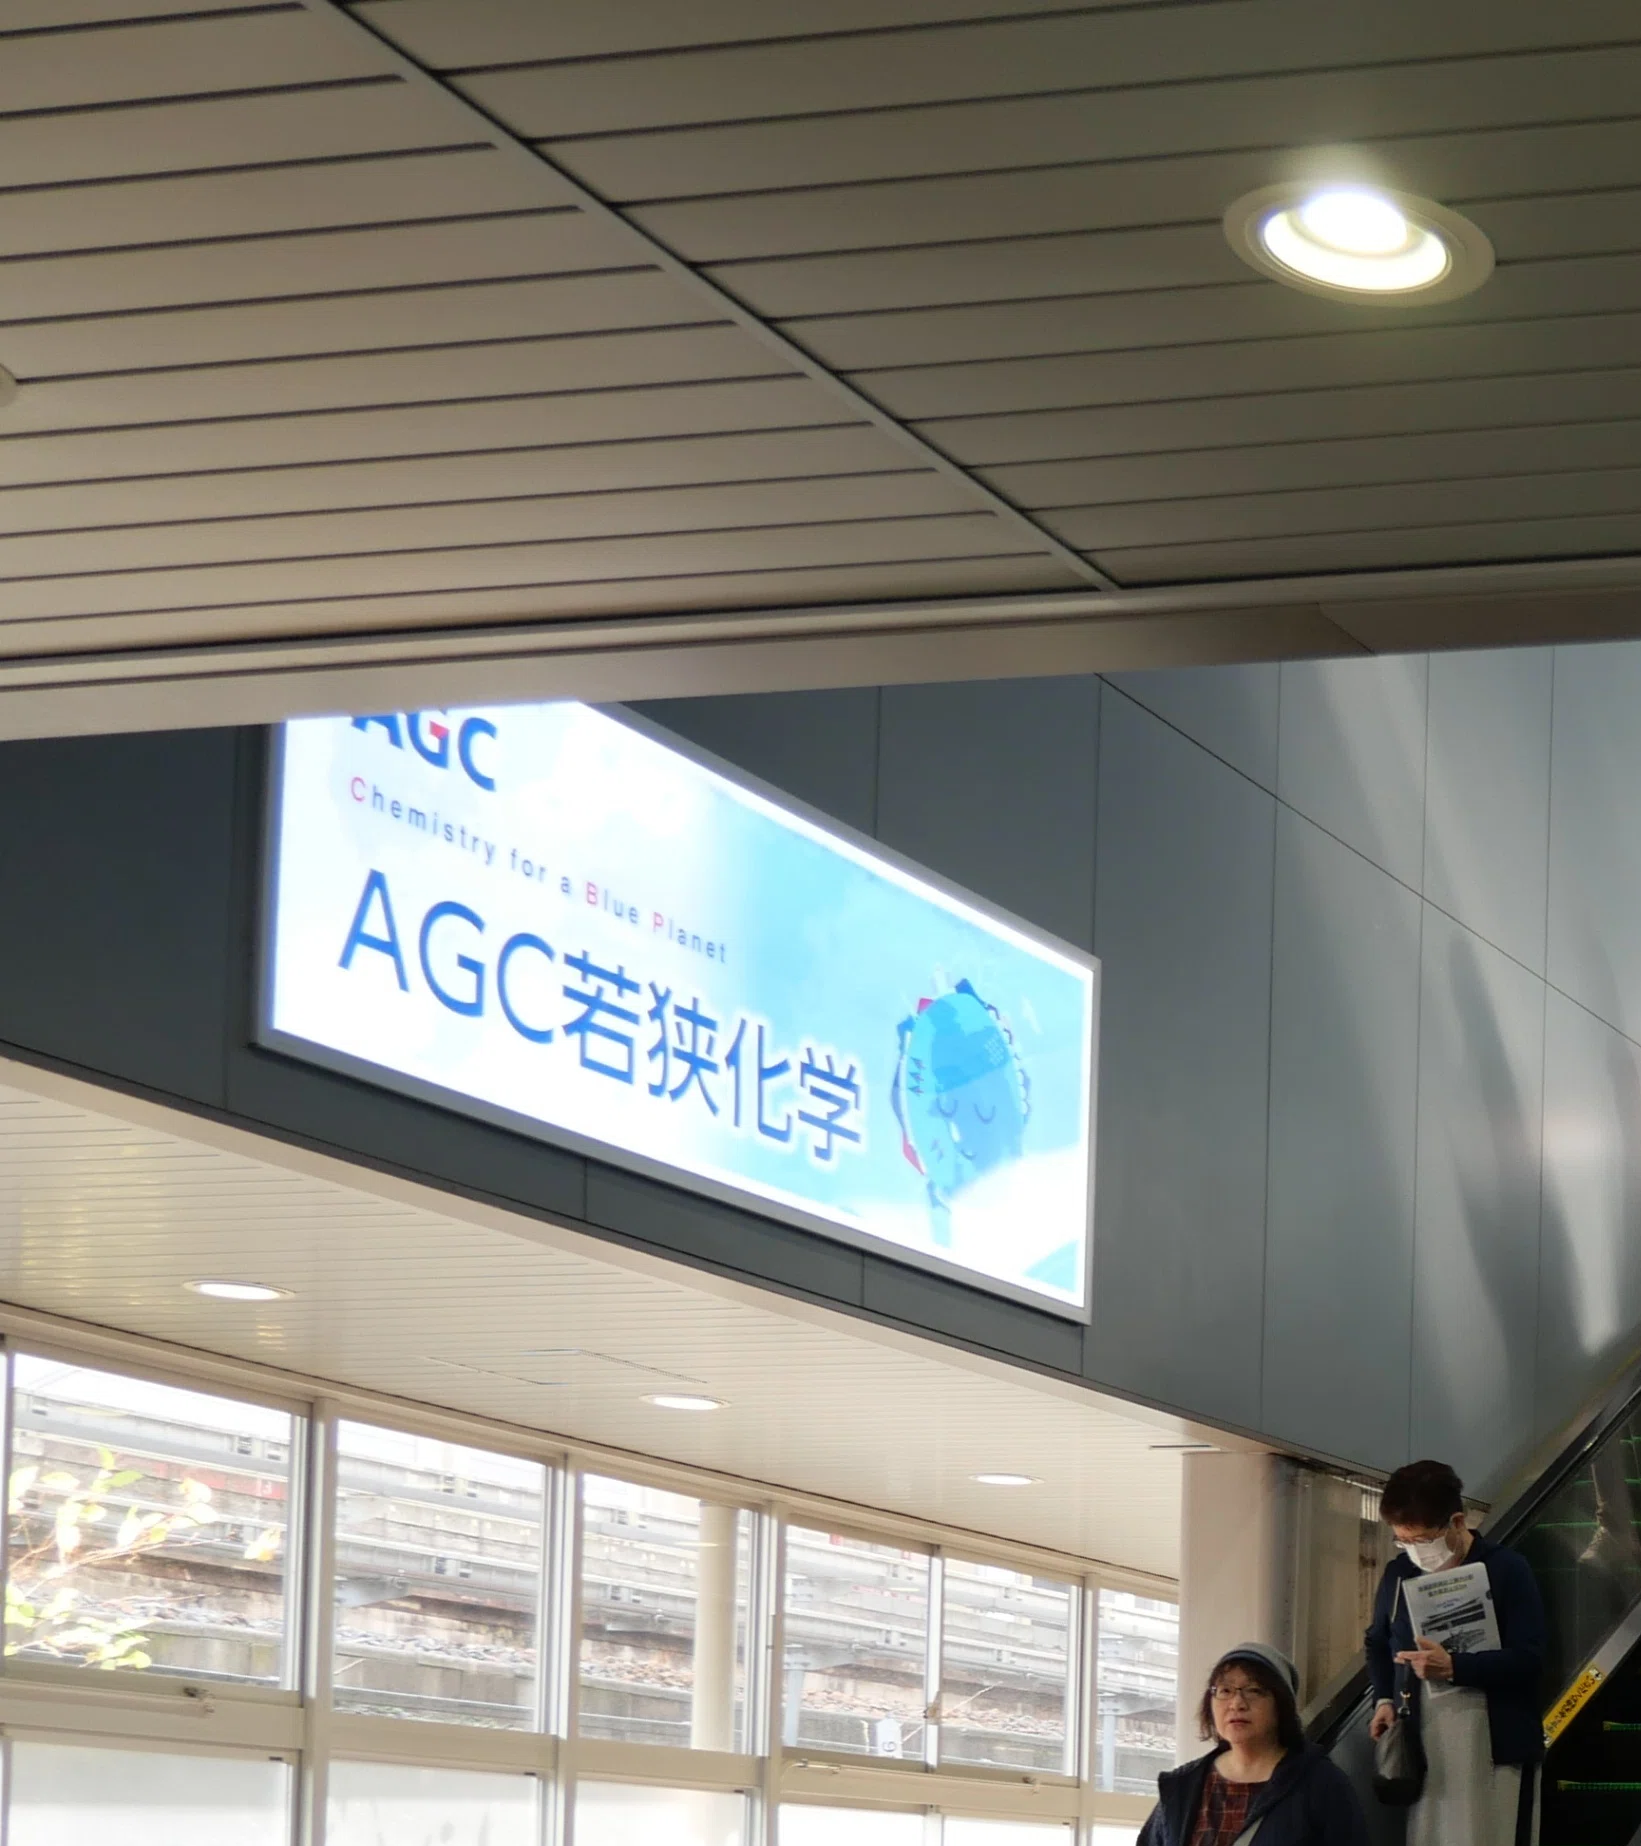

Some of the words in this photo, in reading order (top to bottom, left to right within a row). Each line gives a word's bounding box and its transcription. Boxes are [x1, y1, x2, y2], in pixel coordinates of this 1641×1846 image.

[351, 776, 497, 867] Chemistry
[510, 848, 547, 884] for
[559, 874, 573, 896] a
[586, 881, 641, 927] Blue
[653, 911, 729, 965] Planet
[337, 867, 864, 1164] AGC若狭化学
